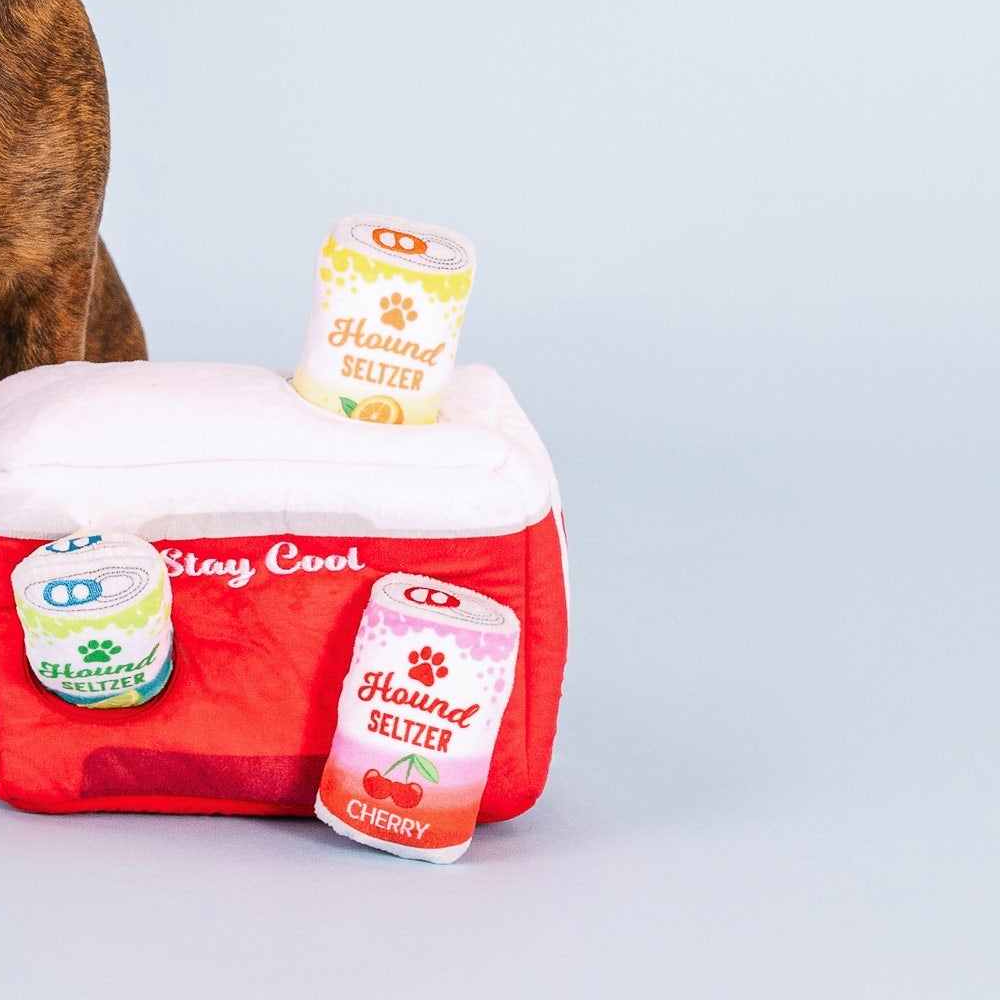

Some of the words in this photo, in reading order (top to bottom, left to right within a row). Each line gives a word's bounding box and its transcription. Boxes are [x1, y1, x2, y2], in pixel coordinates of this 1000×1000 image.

[328, 318, 446, 367] Hound
[341, 354, 425, 391] SELTZER
[160, 547, 256, 589] Stay
[265, 541, 366, 575] Cool
[38, 643, 161, 680] Hound
[61, 672, 146, 692] SELTZER
[357, 671, 480, 729] Hound
[367, 709, 453, 753] SELTZER
[346, 799, 431, 840] CHERRY
